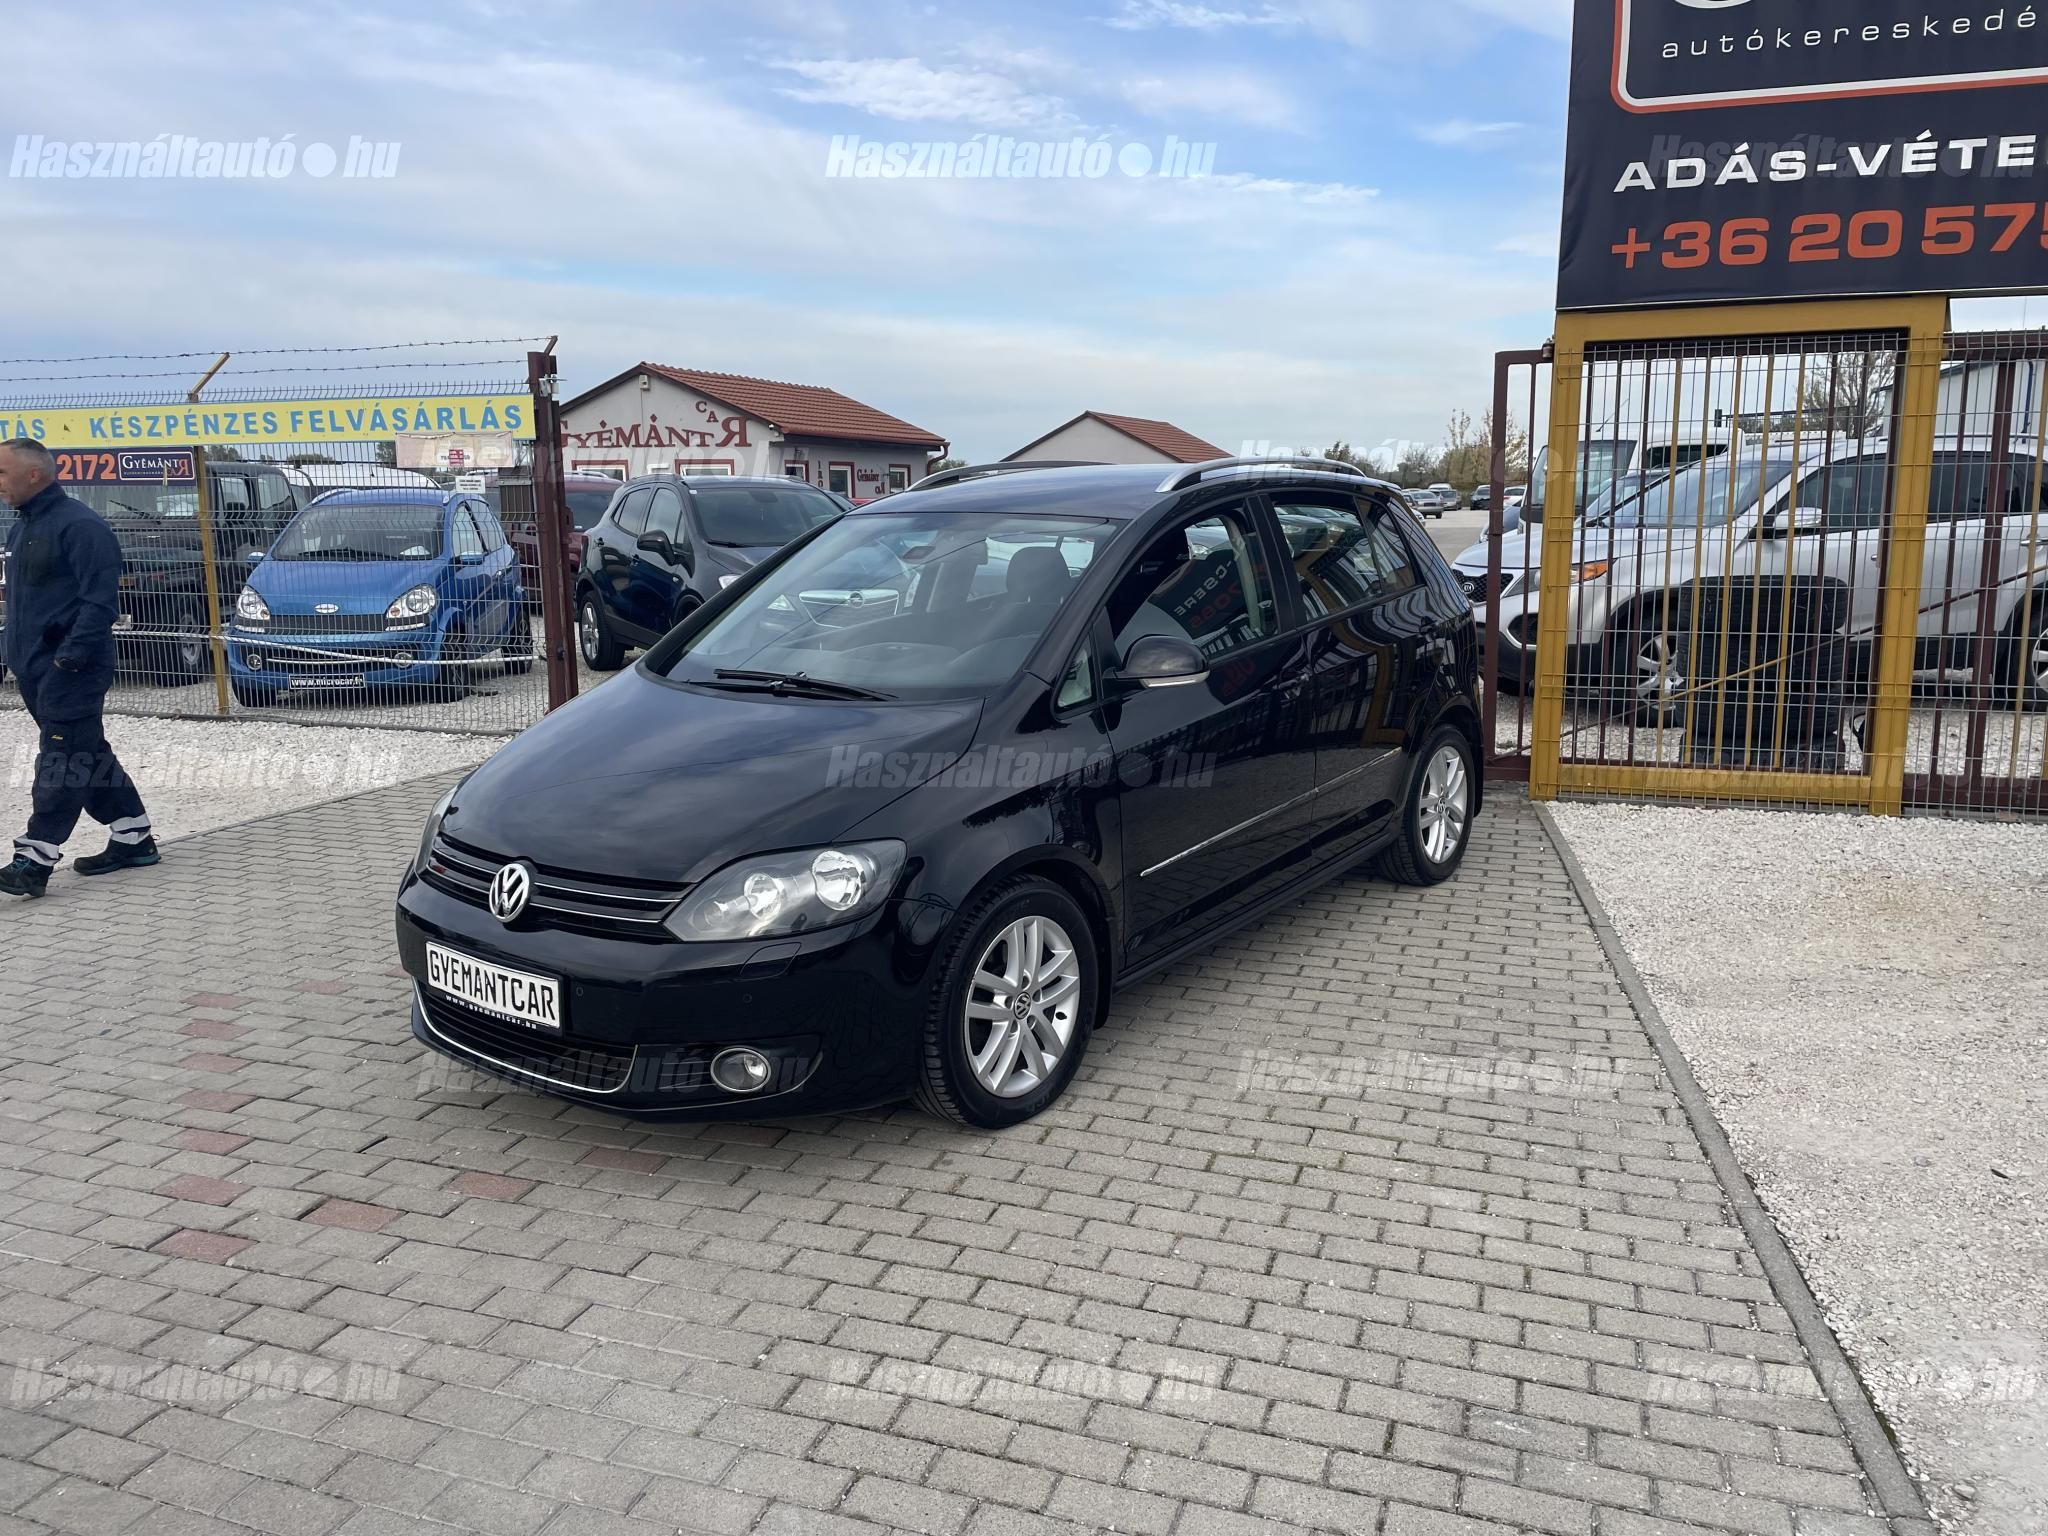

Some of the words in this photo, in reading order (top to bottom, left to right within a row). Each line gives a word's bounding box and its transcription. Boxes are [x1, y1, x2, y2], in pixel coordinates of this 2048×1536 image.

[1613, 129, 2048, 193] ADÁS-VÉTE
[1611, 217, 1770, 270] +36
[1788, 210, 1903, 263] 20
[1920, 202, 2048, 255] 57
[89, 408, 278, 438] KÉSZPÉNZES
[290, 400, 522, 433] FELVÁSÁRLÁS
[56, 453, 117, 480] 2172
[429, 949, 556, 1021] GYEMANTCAR
